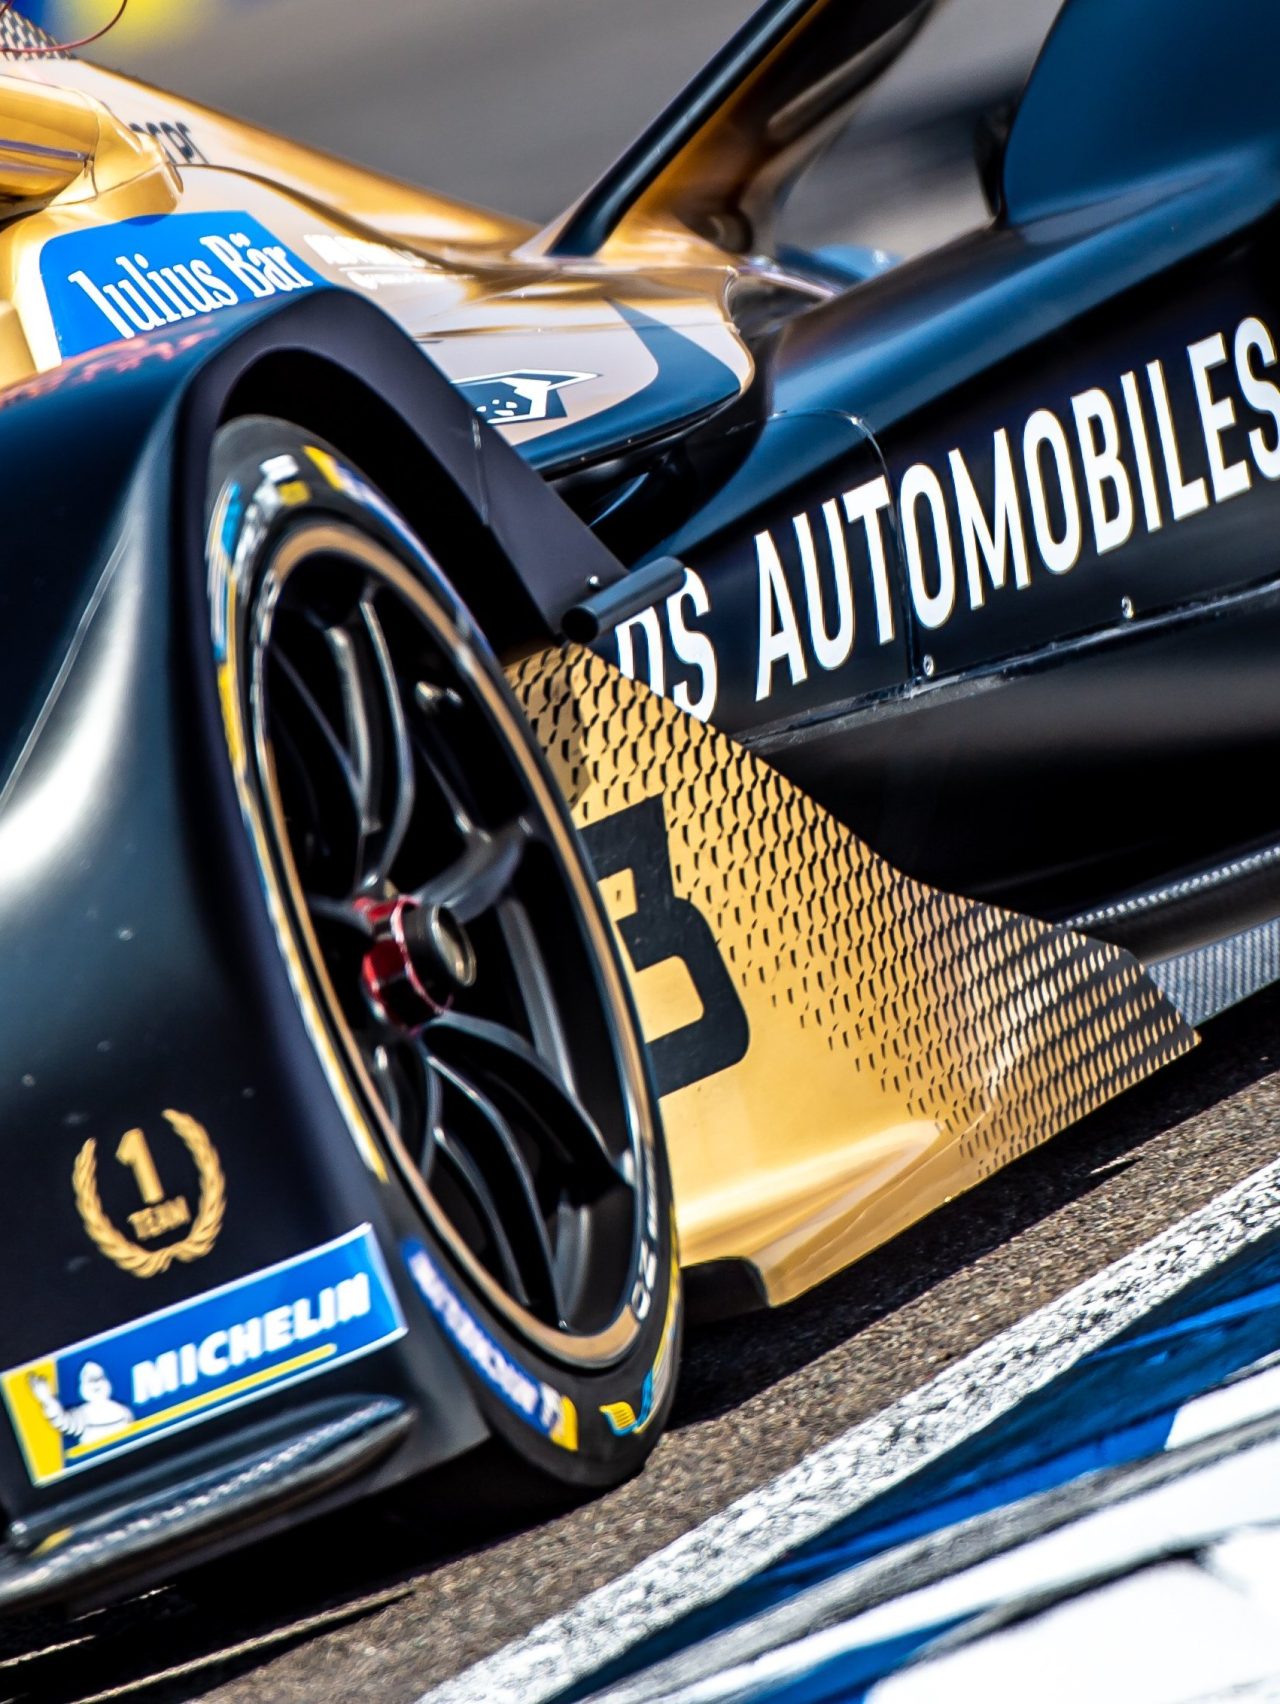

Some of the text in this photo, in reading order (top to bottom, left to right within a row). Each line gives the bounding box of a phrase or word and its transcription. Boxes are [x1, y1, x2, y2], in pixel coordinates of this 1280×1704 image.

[67, 253, 240, 340] Julius
[199, 232, 314, 298] Bär
[753, 316, 1280, 702] AUTOMOBILES
[115, 1126, 165, 1205] 1
[126, 1195, 191, 1241] TEAM
[132, 1272, 371, 1404] MICHELIN
